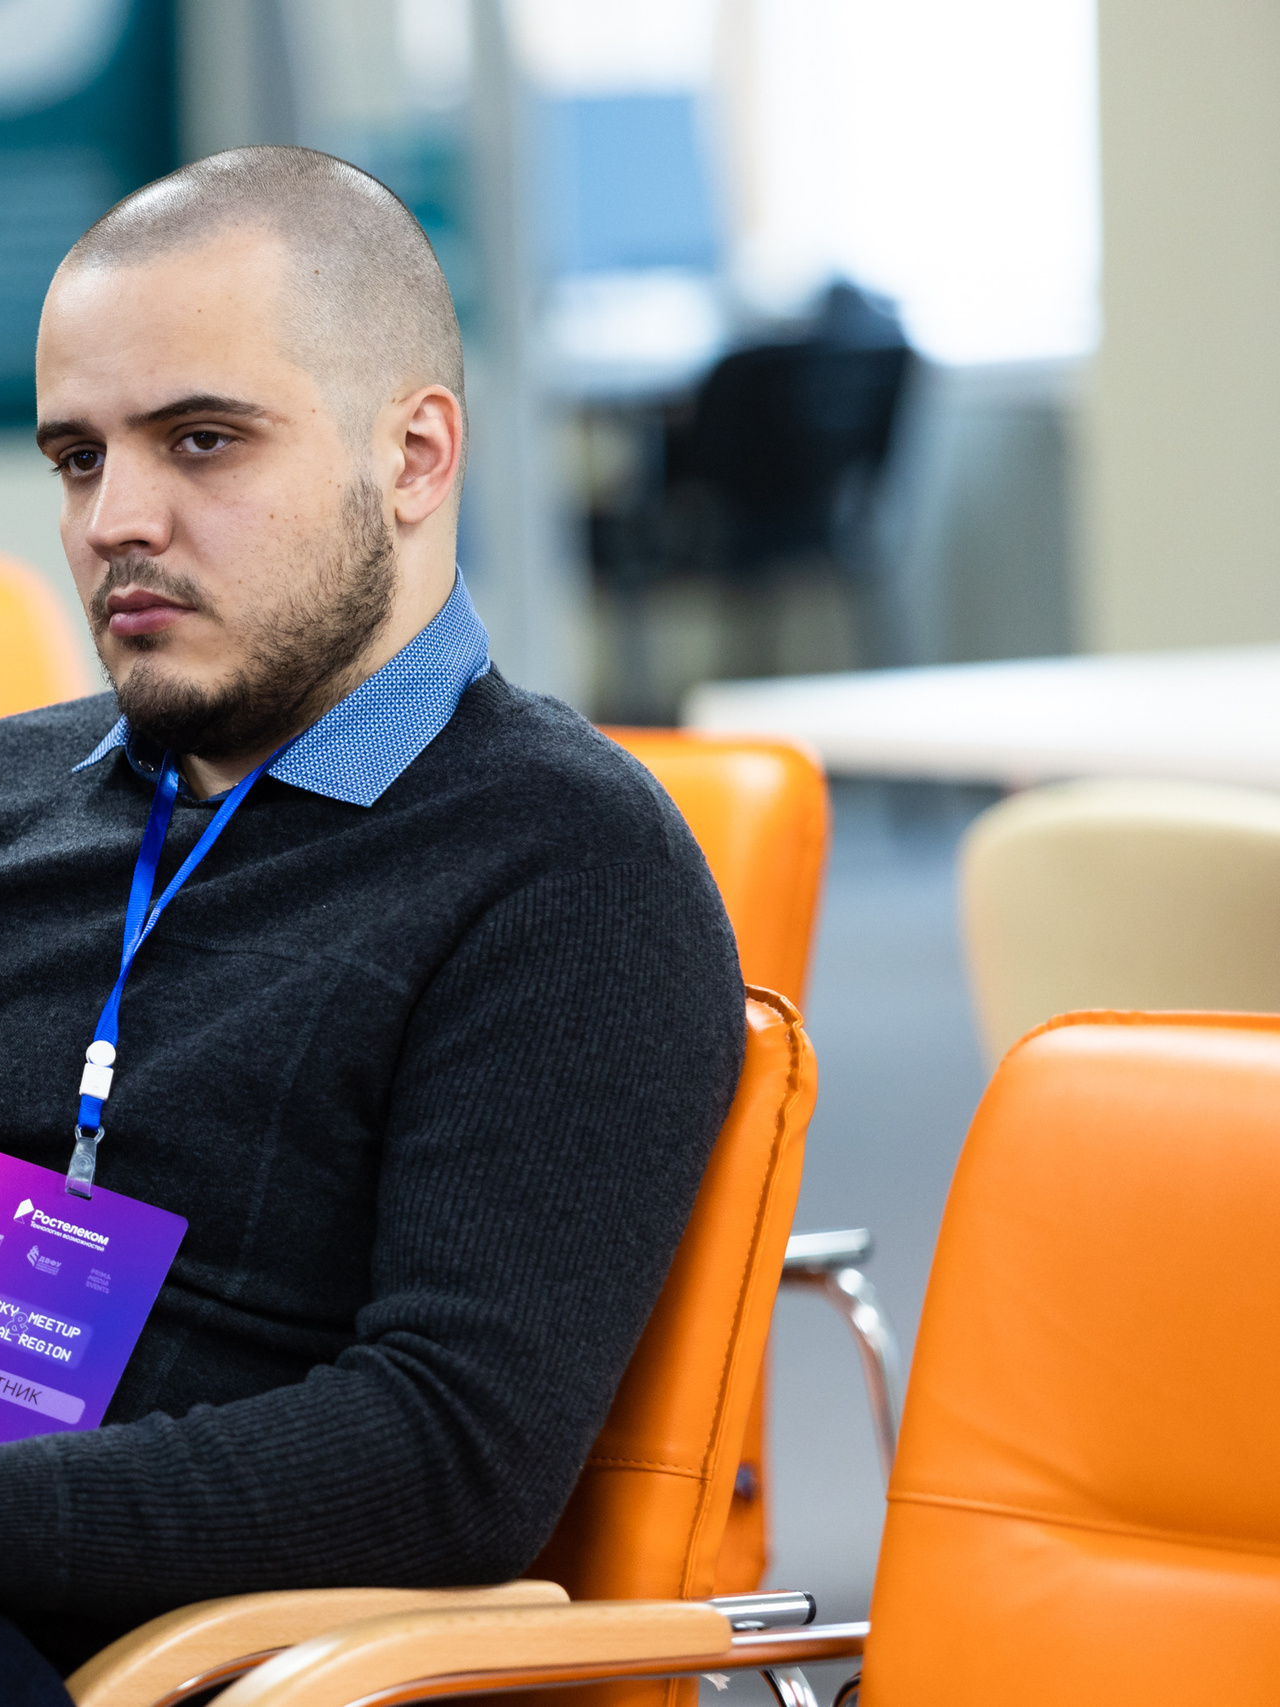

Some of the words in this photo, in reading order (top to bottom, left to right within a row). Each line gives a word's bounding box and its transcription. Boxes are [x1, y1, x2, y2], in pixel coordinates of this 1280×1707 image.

[31, 1209, 110, 1245] Ростелеком
[38, 1255, 62, 1268] ДВФУ
[27, 1312, 81, 1338] MEETUP
[17, 1333, 72, 1362] REGION
